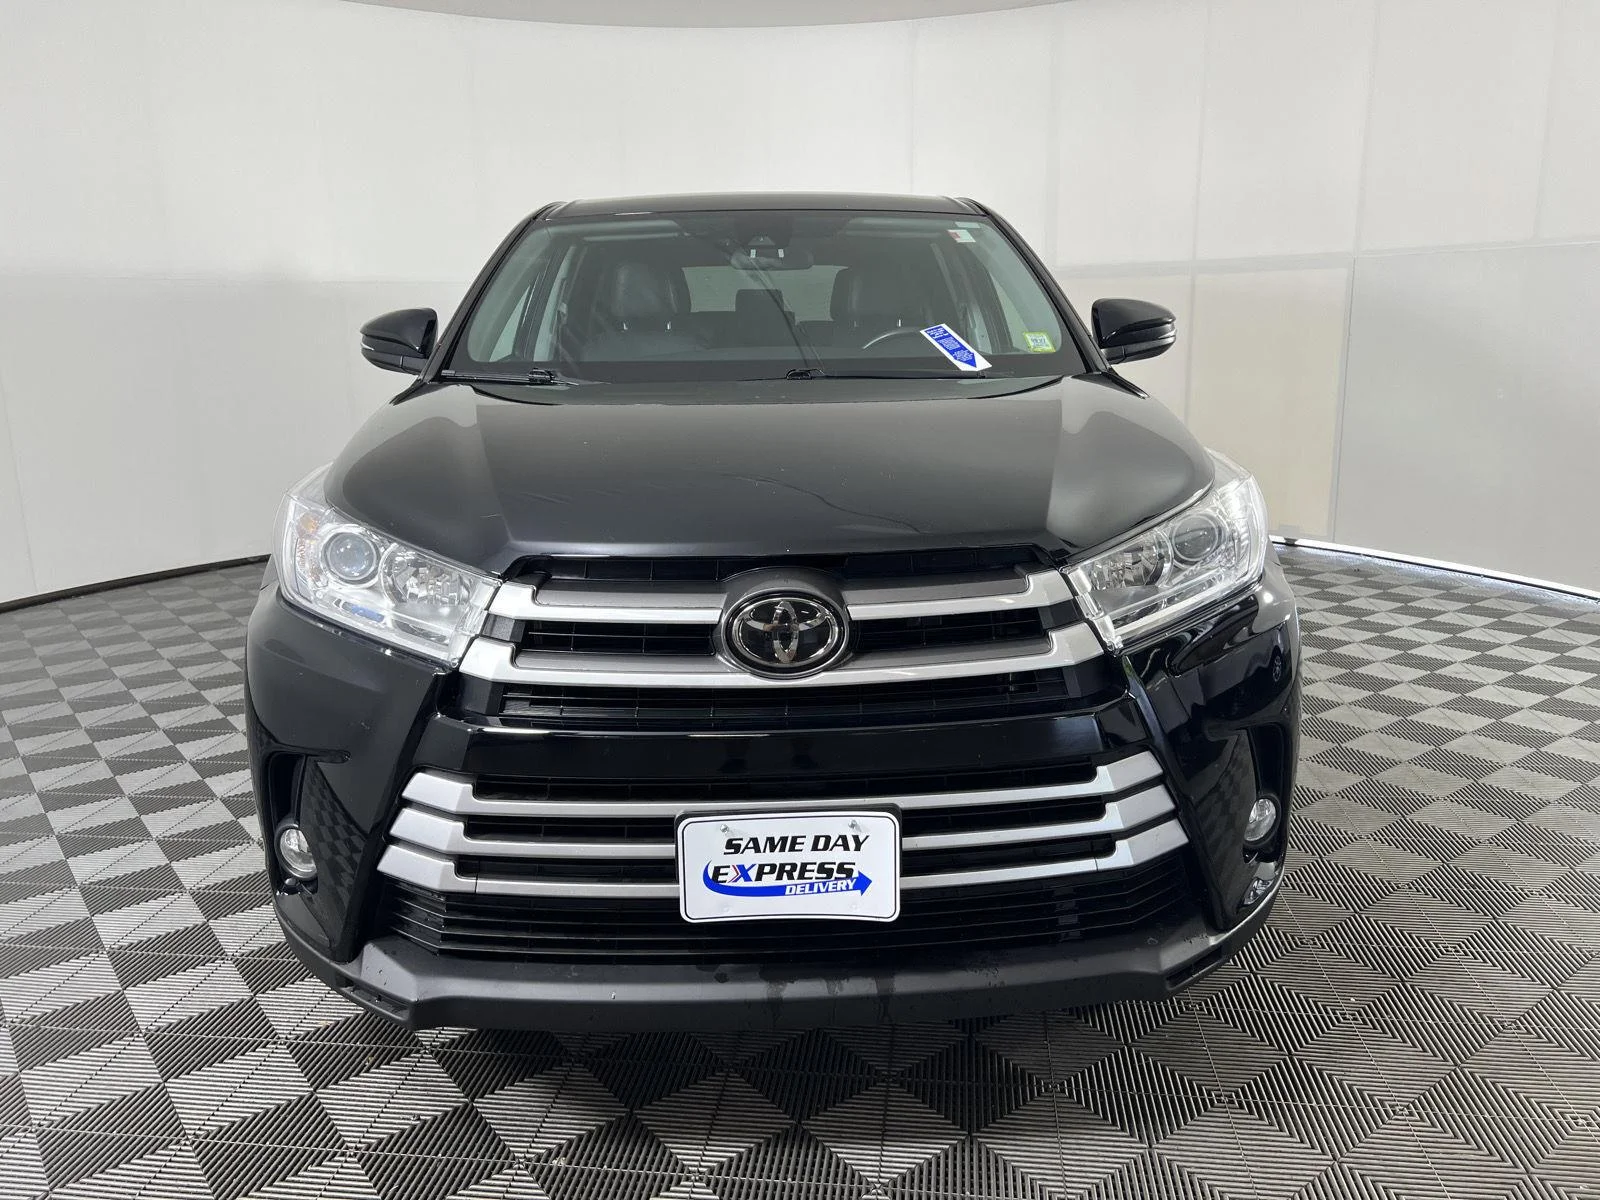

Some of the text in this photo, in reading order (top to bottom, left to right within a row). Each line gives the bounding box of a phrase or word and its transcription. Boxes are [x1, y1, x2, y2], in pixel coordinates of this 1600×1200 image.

[723, 834, 870, 855] SAME DAY
[711, 861, 856, 883] EXPRESS
[784, 878, 857, 896] DELIVERY
